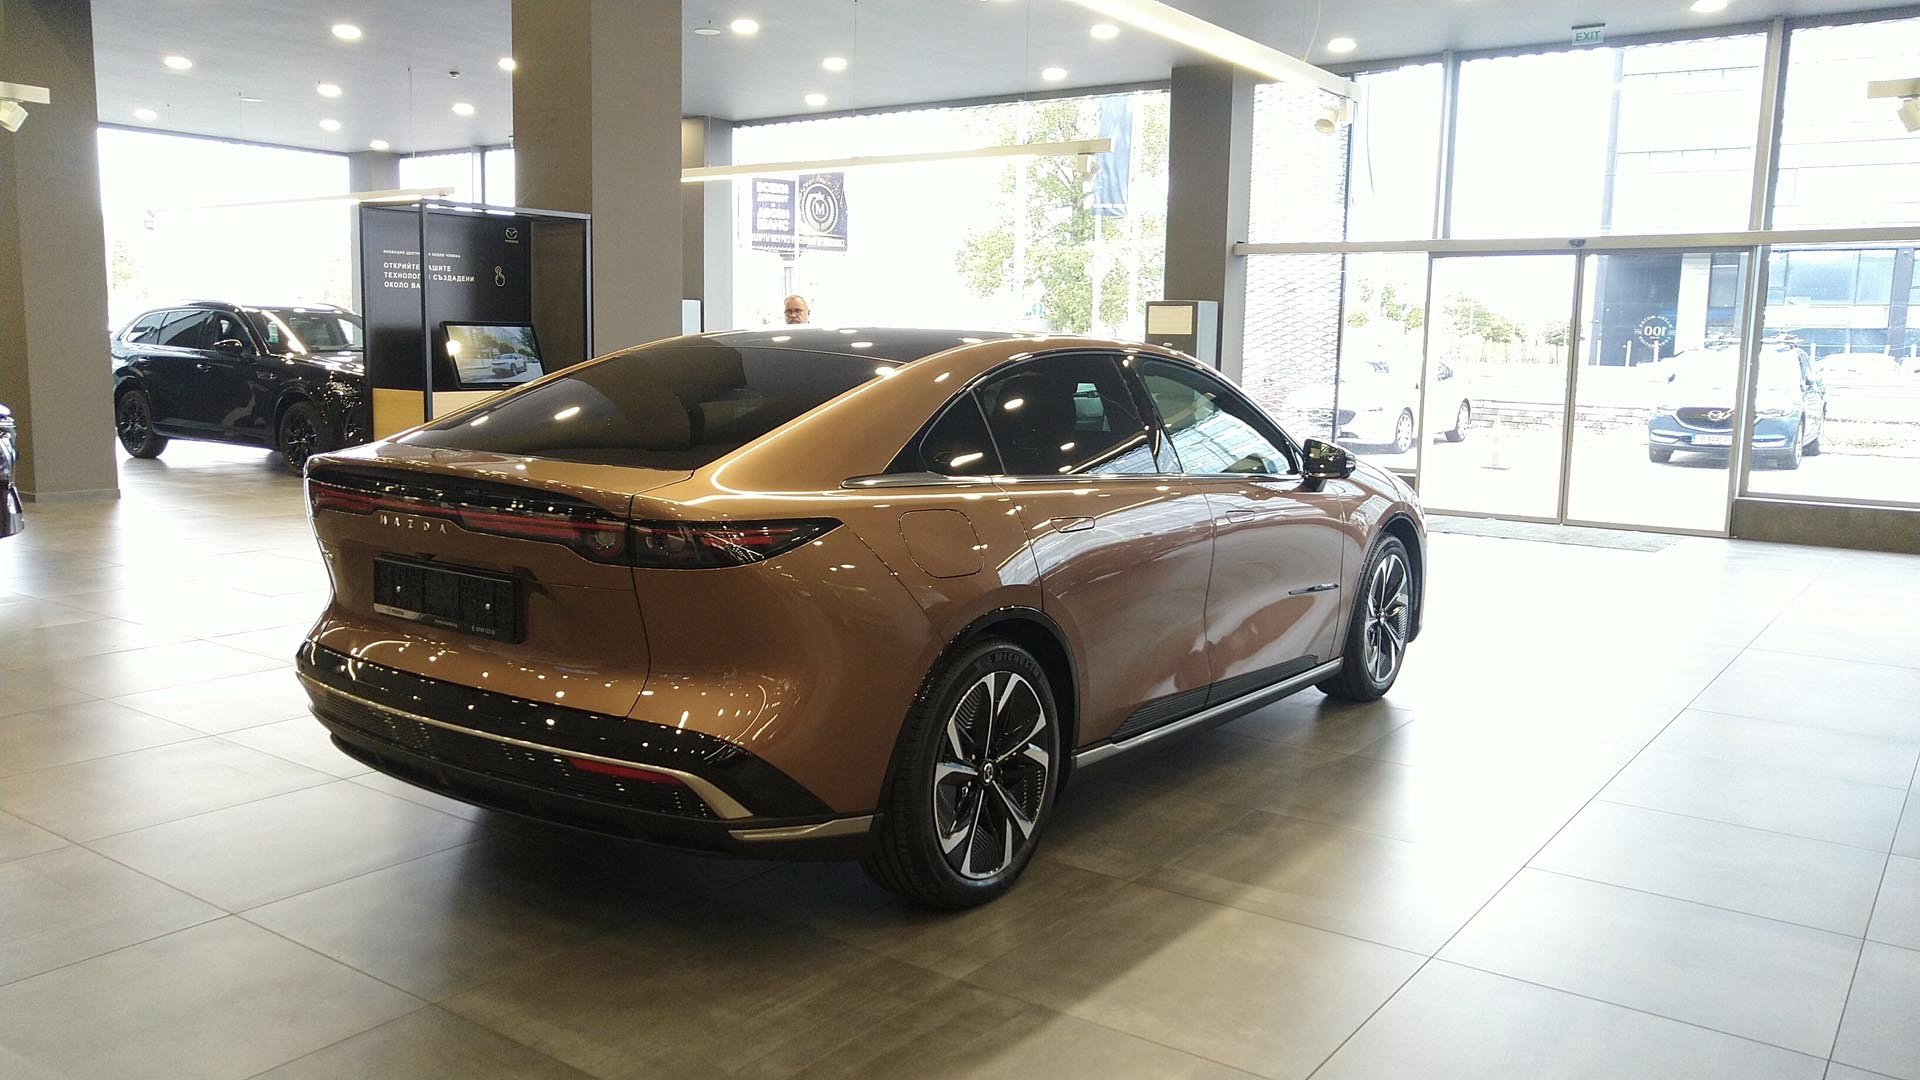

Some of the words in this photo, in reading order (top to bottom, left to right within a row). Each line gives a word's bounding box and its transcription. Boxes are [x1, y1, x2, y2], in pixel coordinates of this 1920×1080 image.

[1575, 31, 1601, 42] EXIT
[383, 262, 421, 271] ОТКРИЙТЕ
[428, 264, 452, 272] АШИТЕ
[383, 271, 431, 280] ТЕХНОЛОГ
[432, 274, 475, 283] СЪЗДАДЕНИ
[384, 281, 409, 289] ОКОЛО
[379, 514, 447, 534] MAZDA
